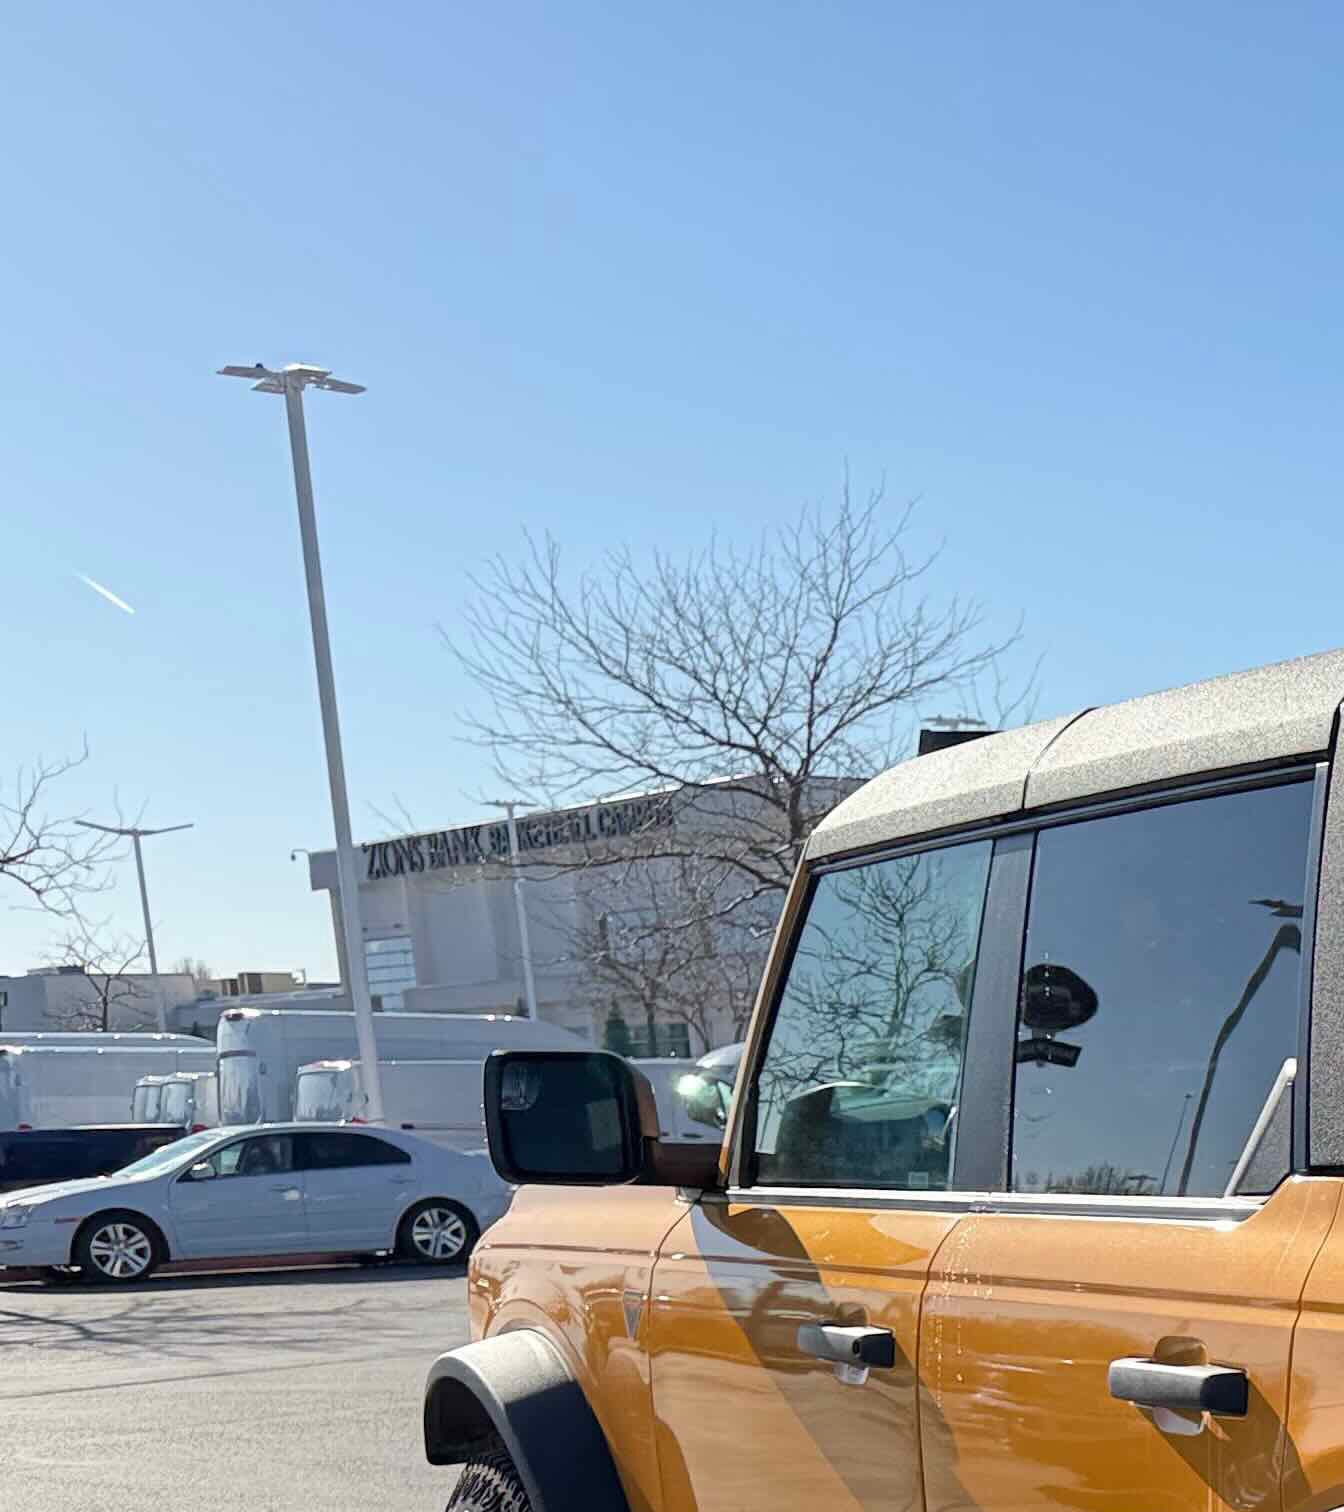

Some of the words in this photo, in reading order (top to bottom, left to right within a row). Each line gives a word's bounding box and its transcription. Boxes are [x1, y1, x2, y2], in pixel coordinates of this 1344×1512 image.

[362, 836, 425, 880] ZIONS
[429, 826, 482, 870] BANK
[487, 812, 598, 857] BAKETBALL
